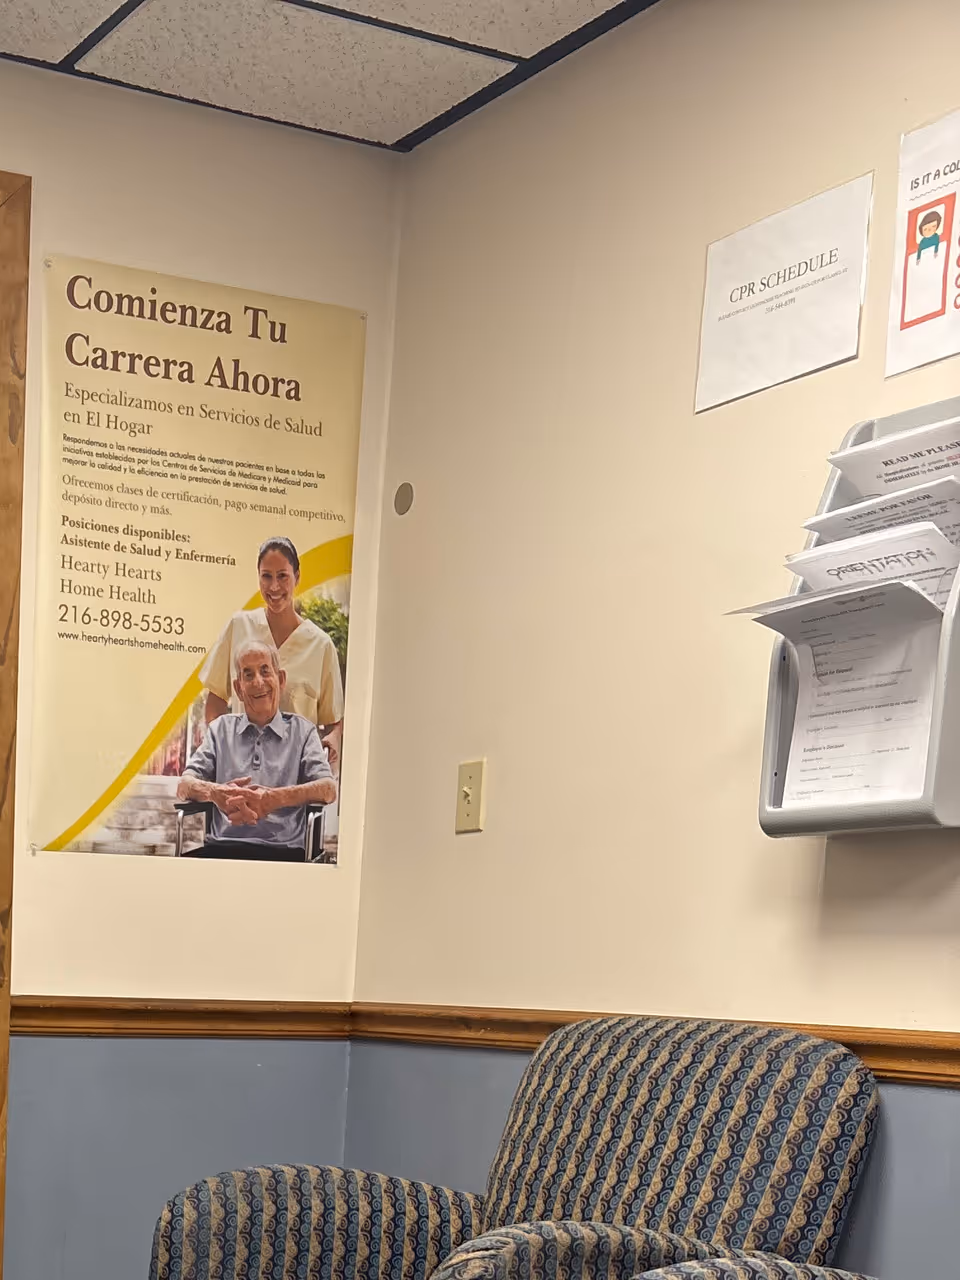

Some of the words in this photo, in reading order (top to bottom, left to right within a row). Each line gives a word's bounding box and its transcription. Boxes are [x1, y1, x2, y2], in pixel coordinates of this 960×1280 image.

[909, 178, 920, 191] IS
[922, 172, 932, 186] IT
[933, 168, 941, 180] A
[729, 281, 756, 303] CPR
[758, 248, 839, 293] SCHEDULE
[66, 275, 232, 334] Comienza
[243, 305, 287, 343] Tu
[65, 333, 196, 383] Carrera
[204, 356, 302, 402] Ahora
[63, 382, 173, 413] Especializamos
[177, 404, 194, 416] en
[199, 403, 259, 427] Servicios
[263, 413, 280, 430] de
[284, 417, 322, 436] Salud
[63, 411, 80, 424] en
[86, 410, 100, 427] El
[105, 414, 153, 437] Hogar
[62, 433, 107, 448] Respondemos
[115, 441, 125, 451] las
[127, 446, 167, 456] necesidades
[168, 451, 196, 460] actuales
[207, 457, 233, 466] nuestros
[235, 461, 264, 470] pacientes
[275, 465, 290, 474] base
[297, 469, 314, 477] todas
[316, 470, 325, 479] las
[62, 444, 94, 457] iniciativas
[95, 452, 135, 463] establecidas
[136, 458, 149, 466] por
[150, 457, 160, 467] los
[161, 459, 187, 470] Centros
[199, 464, 226, 475] Servicios
[237, 470, 266, 481] Medicare
[272, 476, 301, 486] Medicaid
[882, 454, 909, 468] READ
[910, 449, 926, 460] ME
[62, 457, 88, 466] mejorar
[97, 462, 122, 472] calidad
[136, 468, 168, 477] eficiencia
[187, 476, 221, 484] prestación
[232, 481, 258, 490] servicios
[269, 486, 287, 494] salud.
[61, 474, 113, 491] Ofrecemos
[116, 482, 143, 496] clases
[146, 486, 159, 498] de
[160, 490, 221, 507] certificación,
[224, 499, 247, 512] pago
[249, 503, 286, 515] semanal
[288, 509, 346, 523] competitivo,
[61, 489, 102, 506] depósito
[104, 497, 139, 511] directo
[141, 504, 147, 516] y
[150, 505, 172, 515] más.
[61, 515, 119, 534] Posiciones
[122, 524, 191, 542] disponibles:
[60, 534, 110, 550] Asistente
[113, 540, 127, 553] de
[129, 540, 161, 557] Salud
[164, 550, 171, 562] y
[174, 548, 236, 565] Enfermería
[826, 548, 937, 580] ORIENTATION
[60, 554, 109, 579] Hearty
[114, 562, 162, 581] Hearts
[59, 578, 104, 598] Home
[108, 585, 156, 604] Health
[58, 604, 184, 634] 216-898-5533
[57, 632, 207, 653] www.heartyheartshomehealth.com
